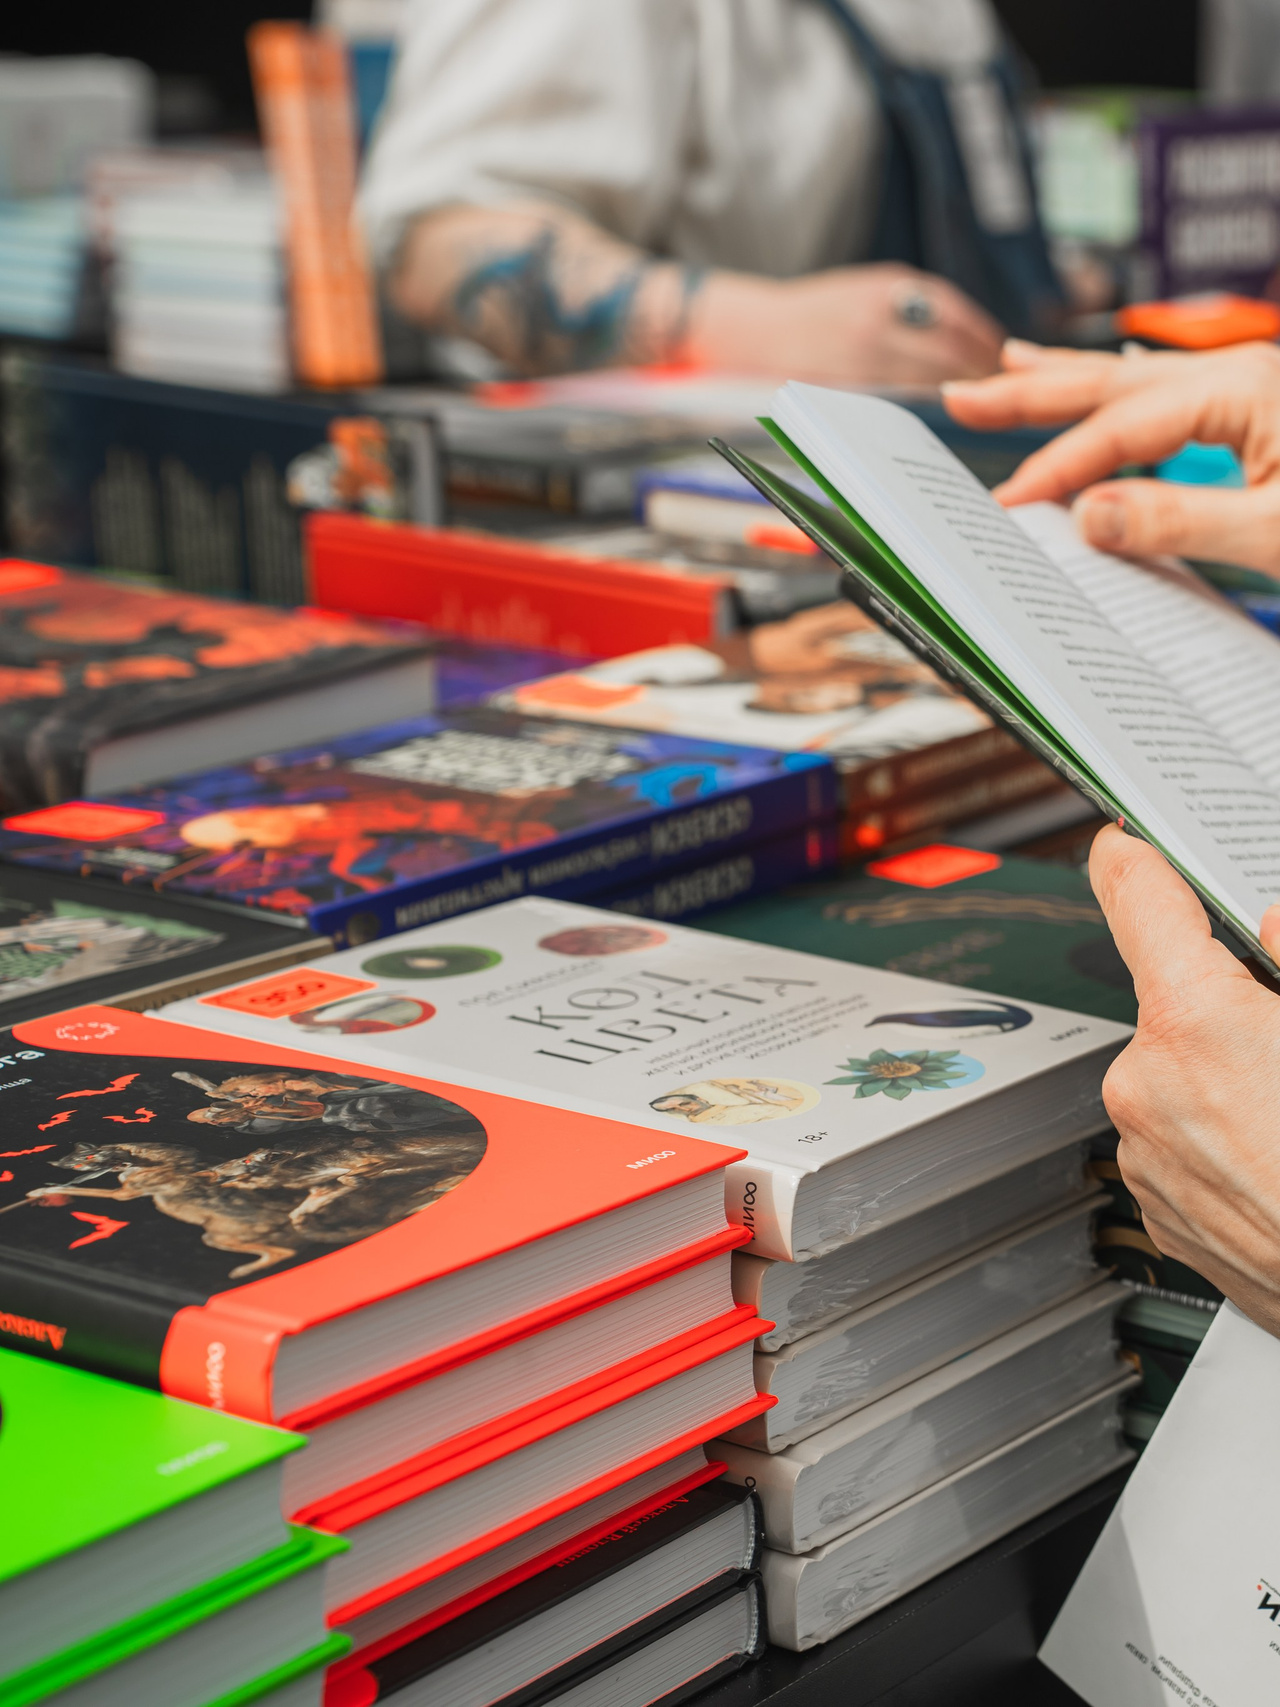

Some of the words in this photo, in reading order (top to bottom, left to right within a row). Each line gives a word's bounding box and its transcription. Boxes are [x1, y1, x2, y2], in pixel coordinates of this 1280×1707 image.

[507, 969, 706, 1030] КОД
[534, 976, 819, 1065] ЦВЕТА
[798, 1129, 829, 1145] 18+
